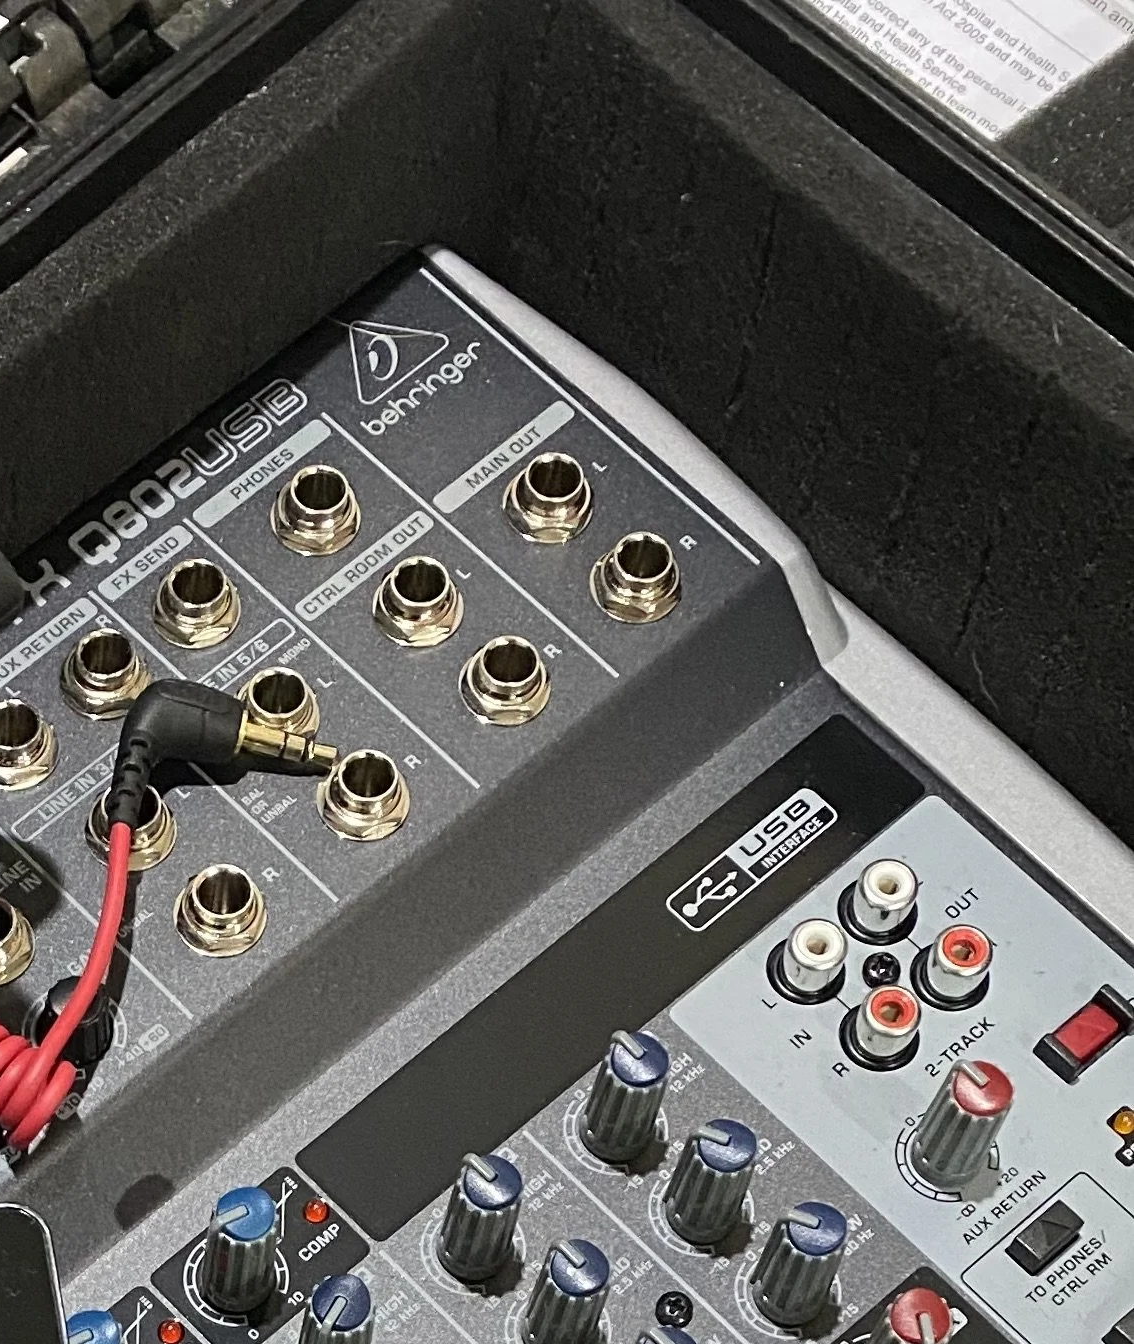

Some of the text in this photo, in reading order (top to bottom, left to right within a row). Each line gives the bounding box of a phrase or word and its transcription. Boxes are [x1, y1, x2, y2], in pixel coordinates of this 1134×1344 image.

[859, 12, 885, 33] and
[883, 28, 922, 62] Health
[1108, 10, 1134, 34] am
[934, 2, 1054, 92] Act 2005 and may be
[994, 27, 1019, 47] and
[1018, 42, 1058, 76] Health
[908, 27, 931, 48] any
[931, 45, 947, 58] of
[946, 53, 965, 72] the
[963, 70, 1018, 107] personal
[946, 95, 976, 119] learn
[360, 340, 481, 437] behringer
[68, 378, 308, 566] Q802USB
[230, 448, 294, 499] PHONES
[466, 426, 543, 490] MAIN OUT
[591, 460, 608, 473] L
[679, 534, 697, 550] R
[112, 536, 181, 592] FX SEND
[303, 518, 427, 616] CTRL ROOM OUT
[456, 568, 473, 580] L
[20, 607, 86, 660] RETURN
[277, 637, 312, 665] MONO
[544, 643, 563, 659] R
[216, 638, 269, 682] IN 5/6
[403, 754, 422, 770] R
[38, 754, 116, 822] LINE IN 3/
[240, 788, 265, 807] BAL
[260, 795, 298, 824] UNBAL
[739, 797, 811, 859] USB
[762, 815, 825, 870] INTERFACE
[19, 872, 42, 894] IN
[262, 867, 281, 883] R
[944, 887, 981, 920] OUT
[762, 997, 778, 1010] L
[789, 1027, 813, 1050] IN
[924, 1016, 996, 1078] 2-TRACK
[832, 1061, 851, 1078] R
[996, 1166, 1020, 1187] +20
[962, 1170, 1047, 1246] AUX RETURN
[298, 1223, 341, 1262] COMP
[1025, 1229, 1106, 1303] TO PHONES/
[1051, 1252, 1113, 1306] CTRL RM
[288, 1290, 306, 1306] 10
[247, 1328, 261, 1341] 0
